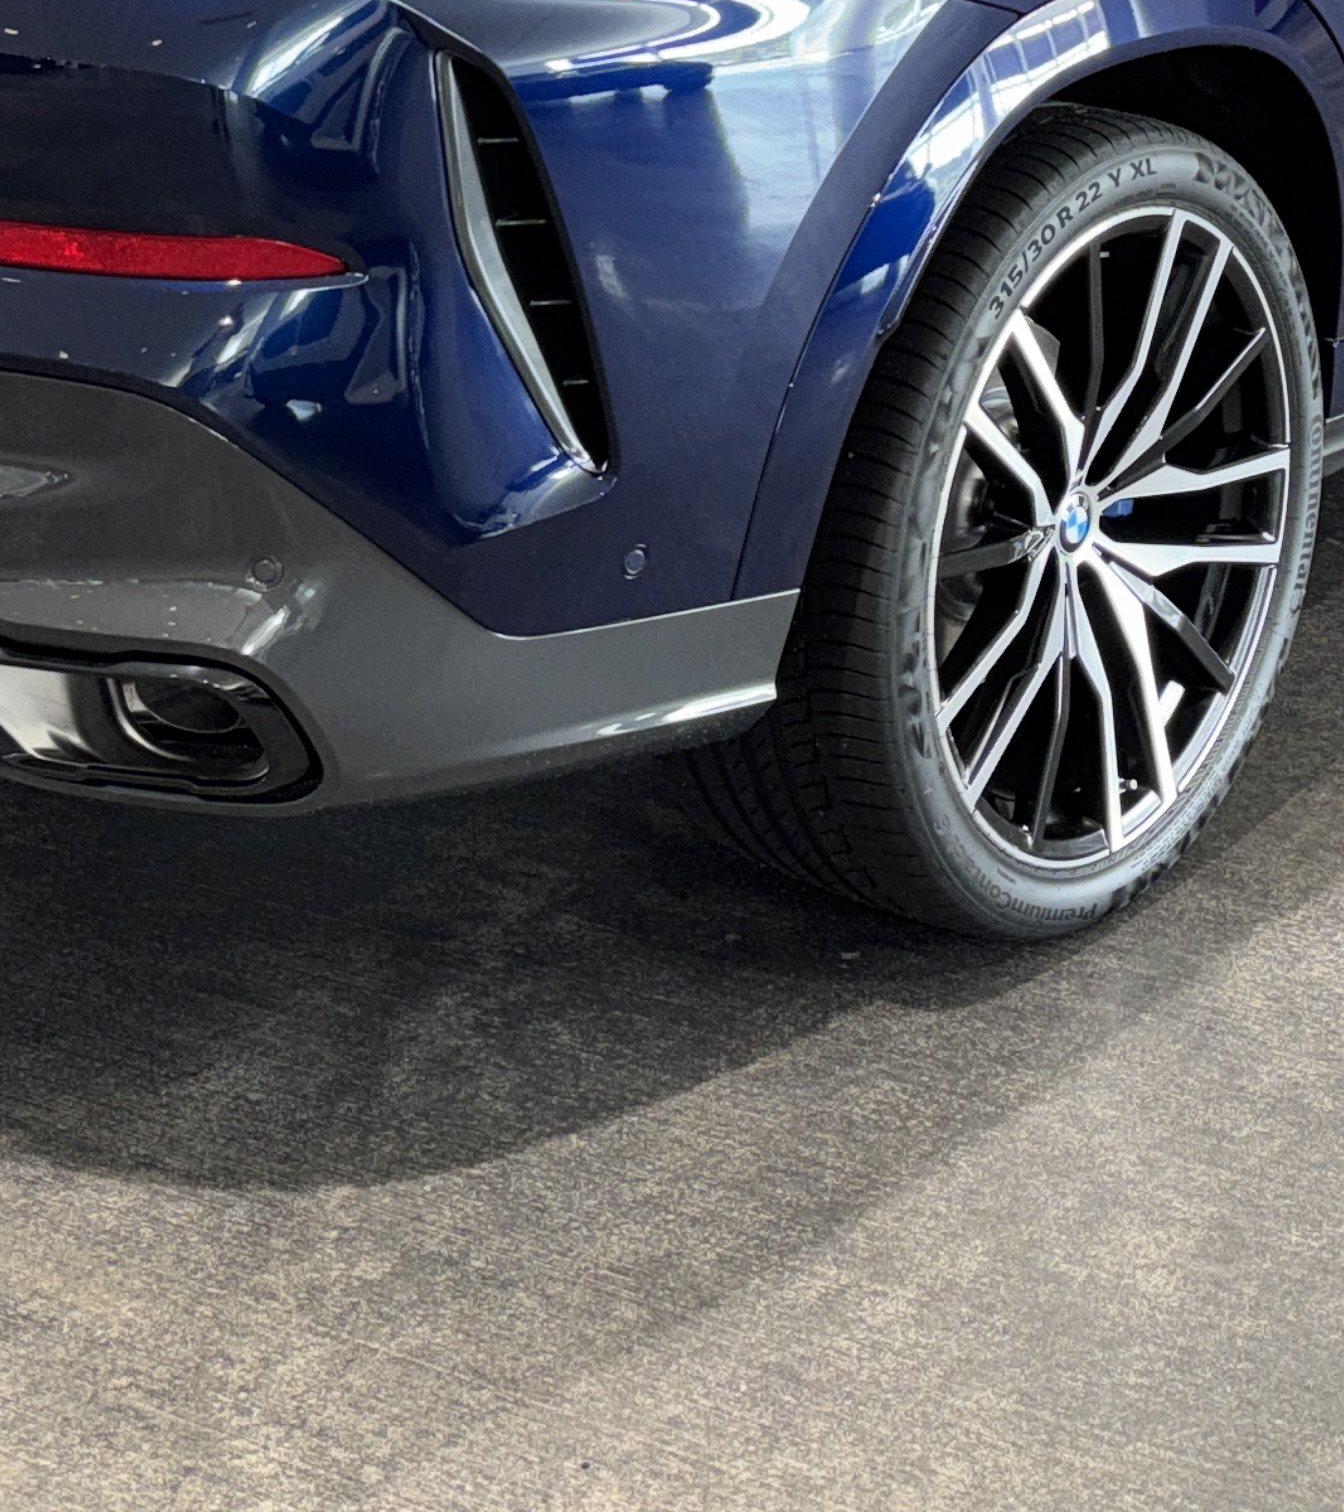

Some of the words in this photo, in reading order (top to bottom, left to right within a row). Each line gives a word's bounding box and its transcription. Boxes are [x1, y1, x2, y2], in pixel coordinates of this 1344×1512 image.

[988, 223, 1057, 320] 315/30
[1075, 181, 1104, 214] 22
[1107, 168, 1124, 190] Y
[1129, 157, 1158, 180] XL
